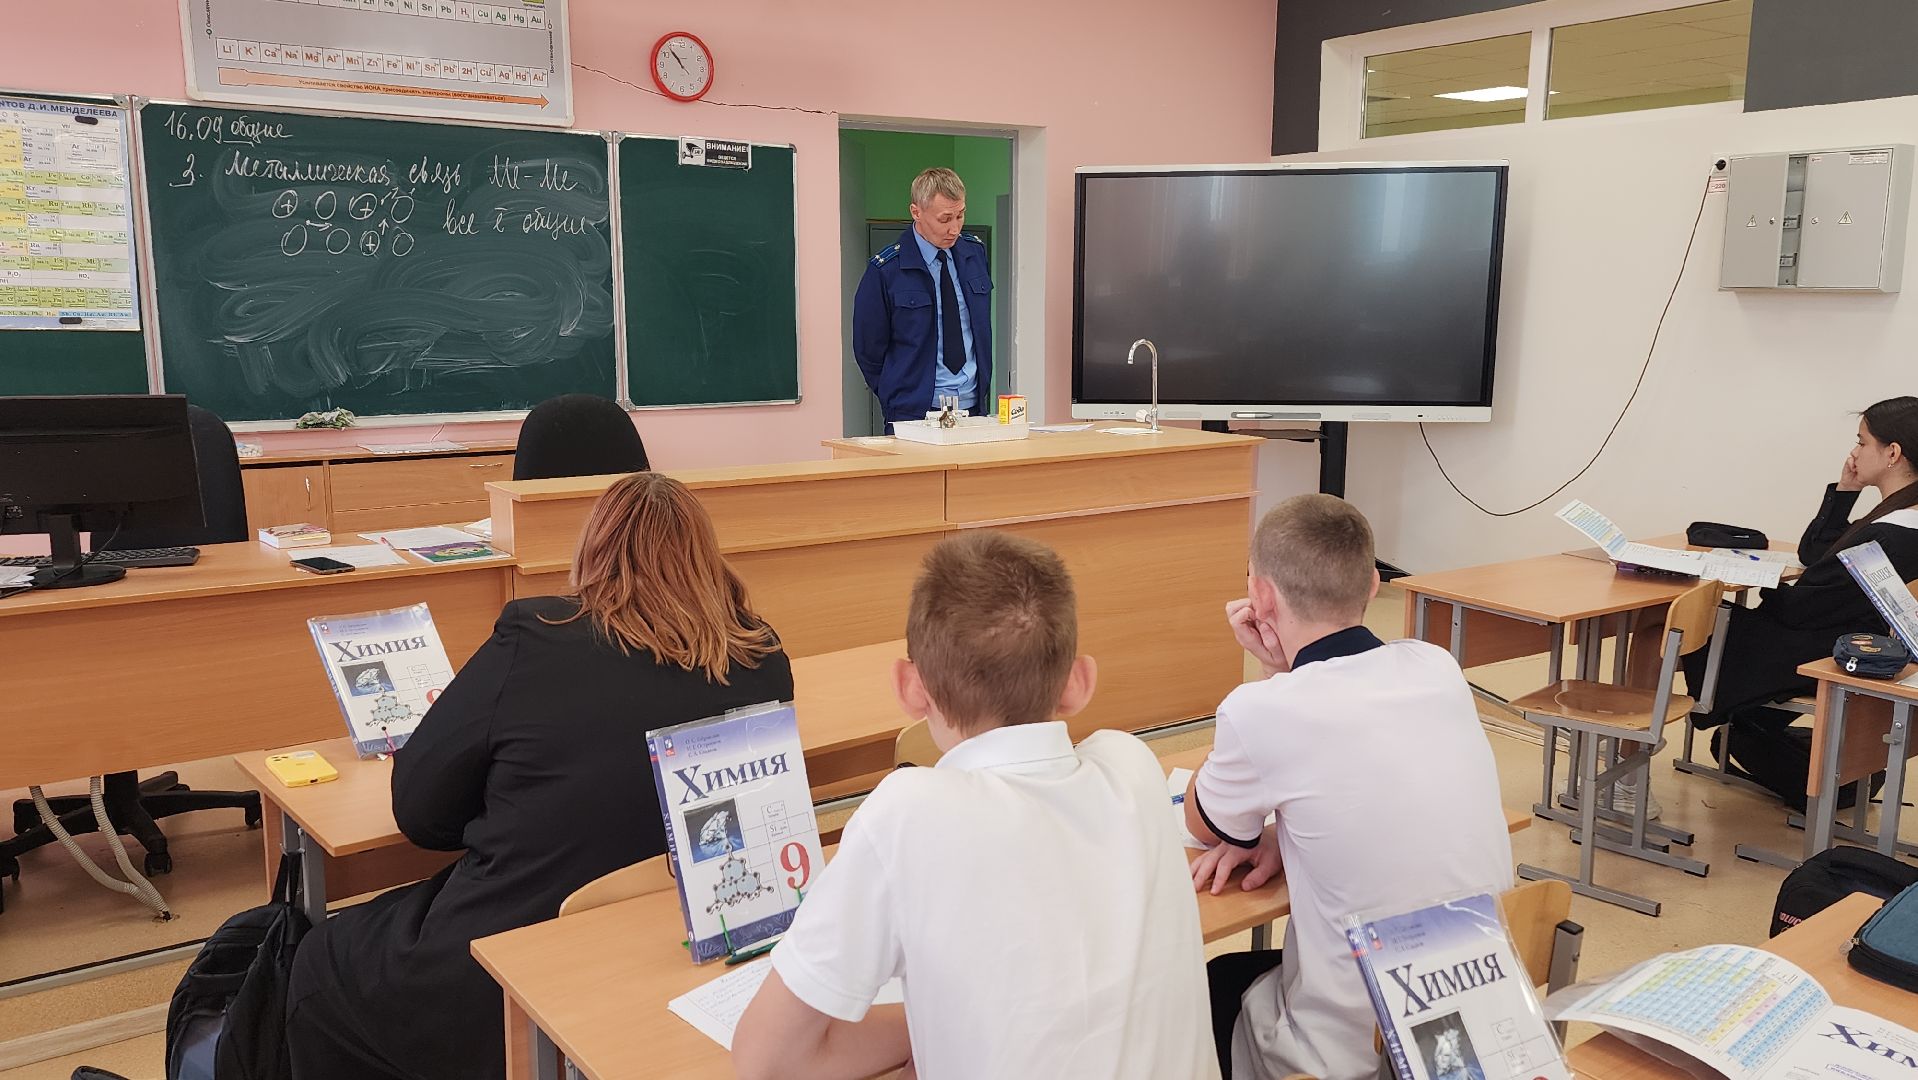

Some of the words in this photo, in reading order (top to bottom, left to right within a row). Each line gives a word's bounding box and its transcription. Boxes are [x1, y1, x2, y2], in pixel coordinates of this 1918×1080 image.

[404, 1, 413, 10] Ni
[421, 3, 433, 11] Sn
[441, 5, 452, 14] Pb
[477, 9, 489, 18] Cu
[495, 11, 507, 21] Ag
[513, 15, 525, 24] Hg
[164, 110, 222, 145] 16.09
[329, 635, 429, 663] Химия
[672, 751, 791, 806] Химия
[780, 841, 811, 889] 9
[1384, 952, 1507, 1018] Химия
